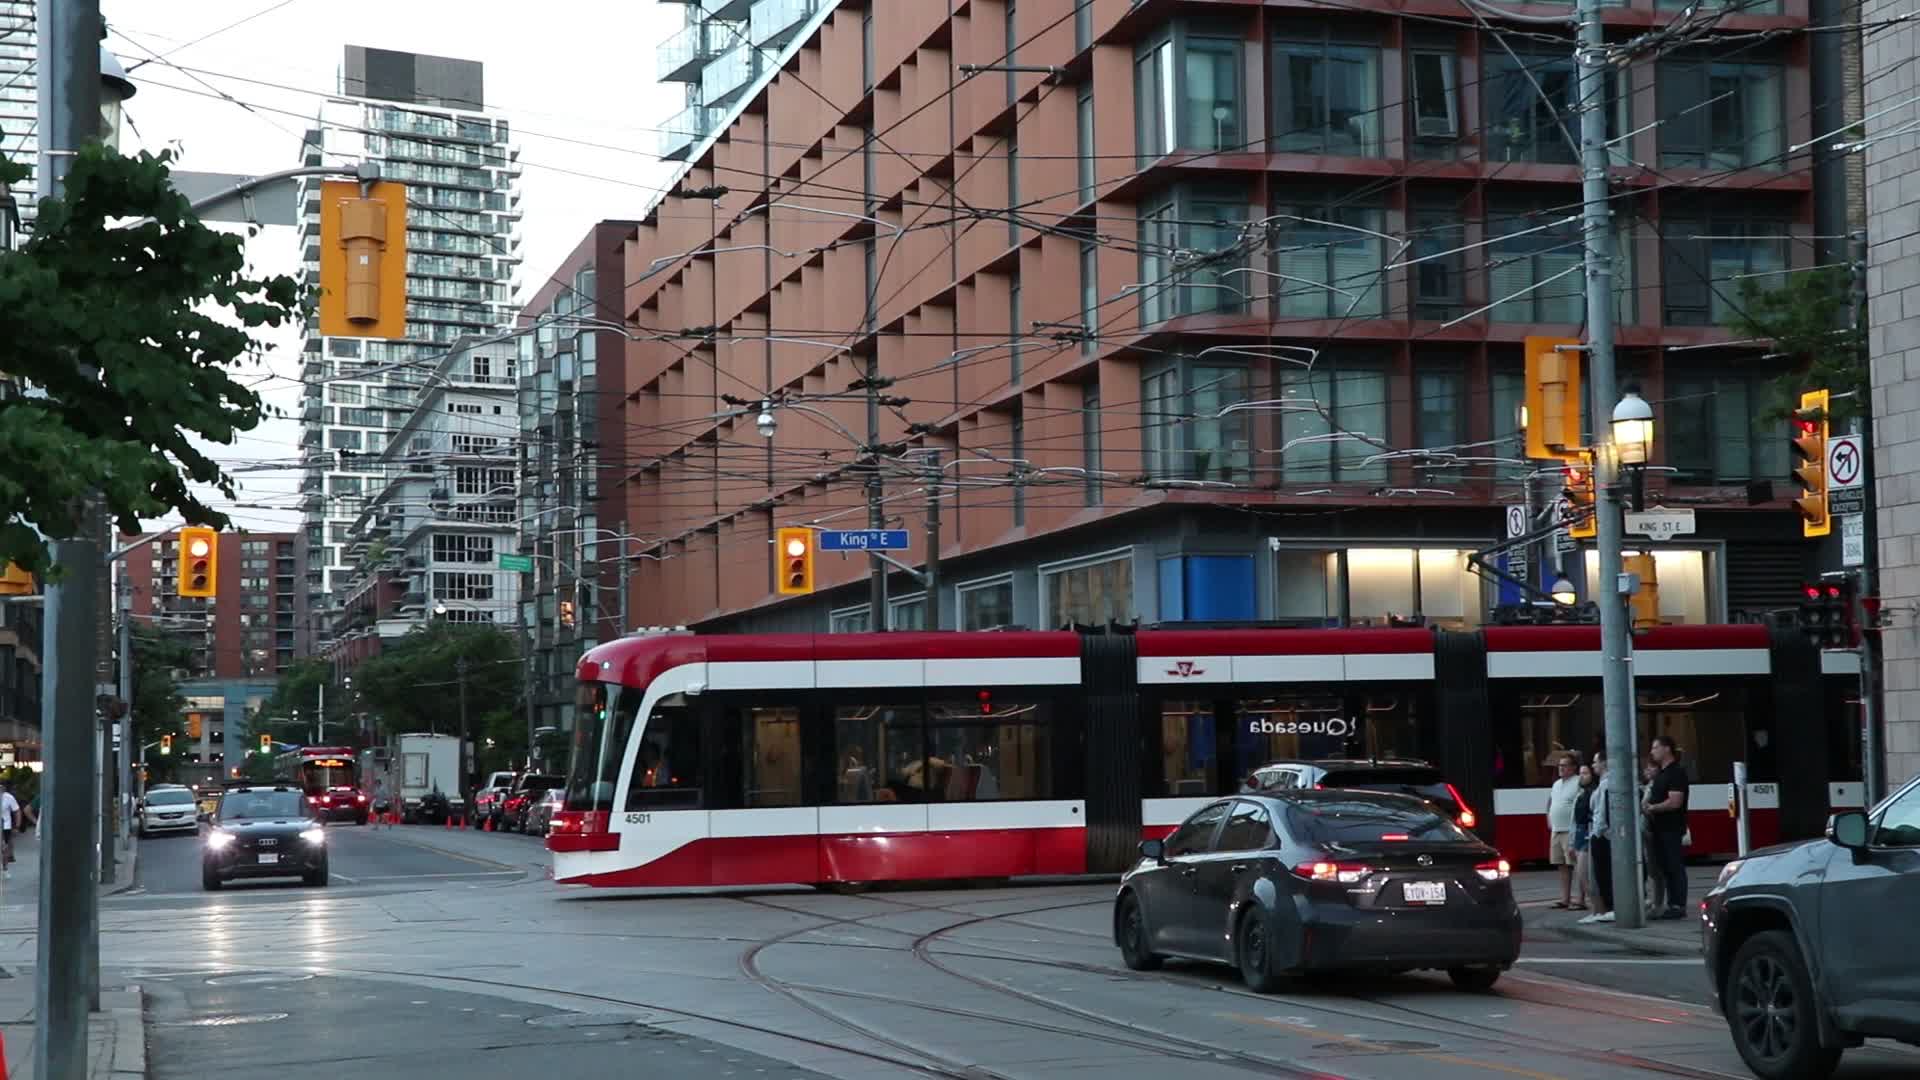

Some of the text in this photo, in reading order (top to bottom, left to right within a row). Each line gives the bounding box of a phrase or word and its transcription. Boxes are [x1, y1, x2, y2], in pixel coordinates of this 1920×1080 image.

[1639, 522, 1657, 532] KING
[840, 532, 868, 549] King
[880, 532, 888, 545] E
[625, 813, 651, 824] 4501
